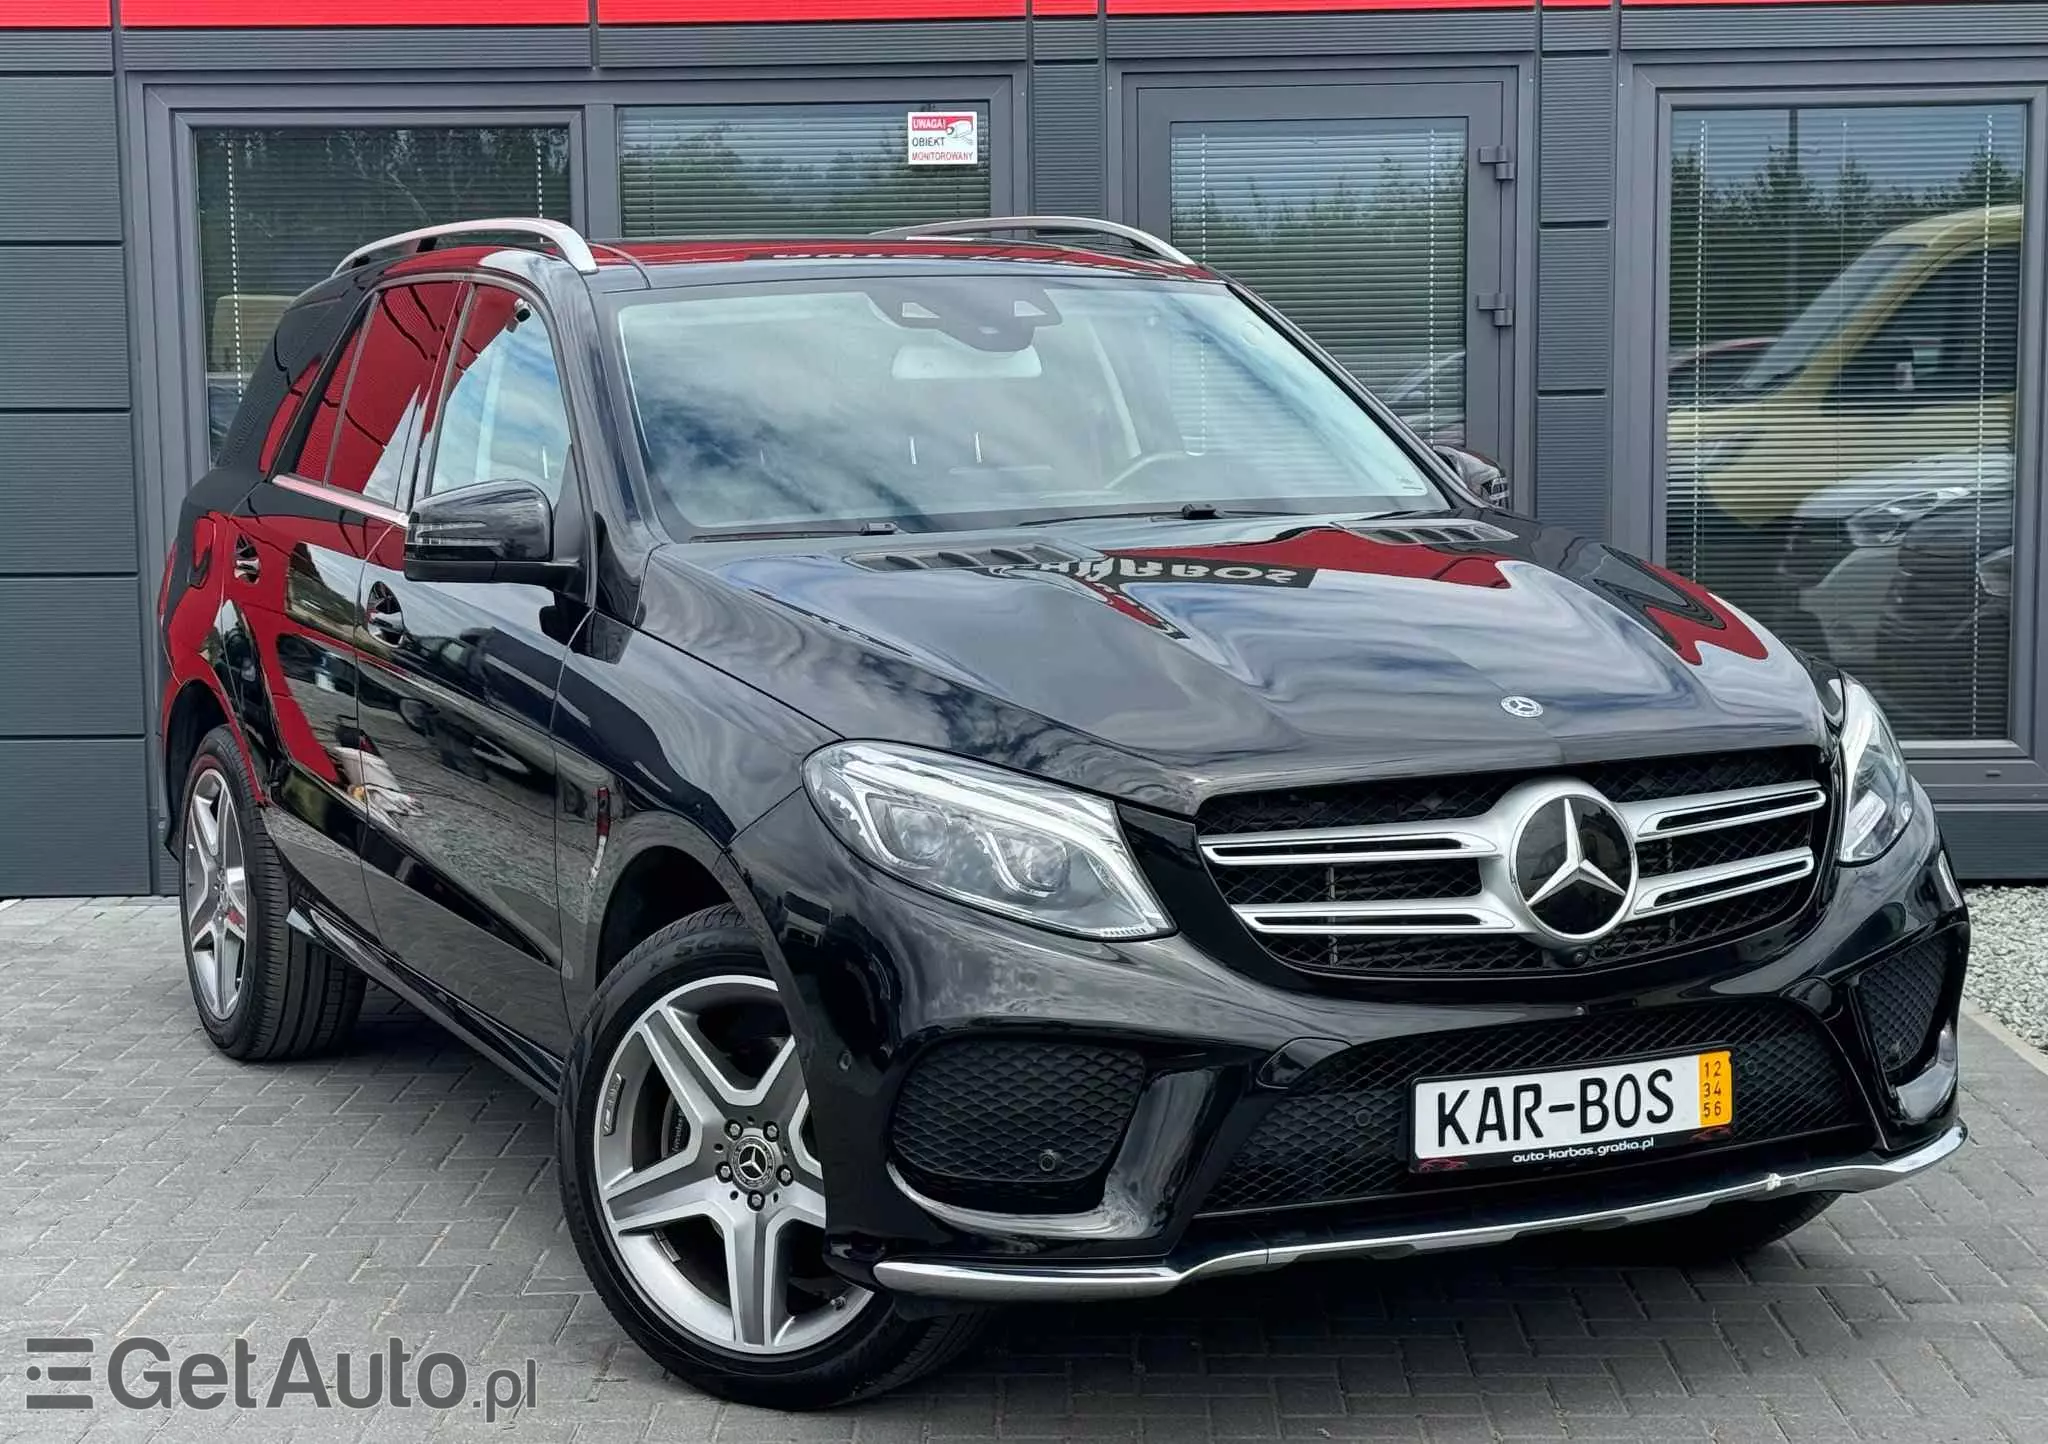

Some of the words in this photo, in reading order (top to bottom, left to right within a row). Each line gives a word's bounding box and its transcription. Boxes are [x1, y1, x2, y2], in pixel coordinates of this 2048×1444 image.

[912, 118, 946, 129] UWAGA!
[912, 137, 945, 147] OBIEKT
[911, 151, 974, 161] MONITOROWANY
[1704, 1060, 1722, 1078] 12
[1703, 1080, 1722, 1098] 34
[1437, 1068, 1675, 1148] KAR-BOS
[1703, 1100, 1722, 1118] 56
[1512, 1136, 1654, 1163] auto-karbos.gratka.pl
